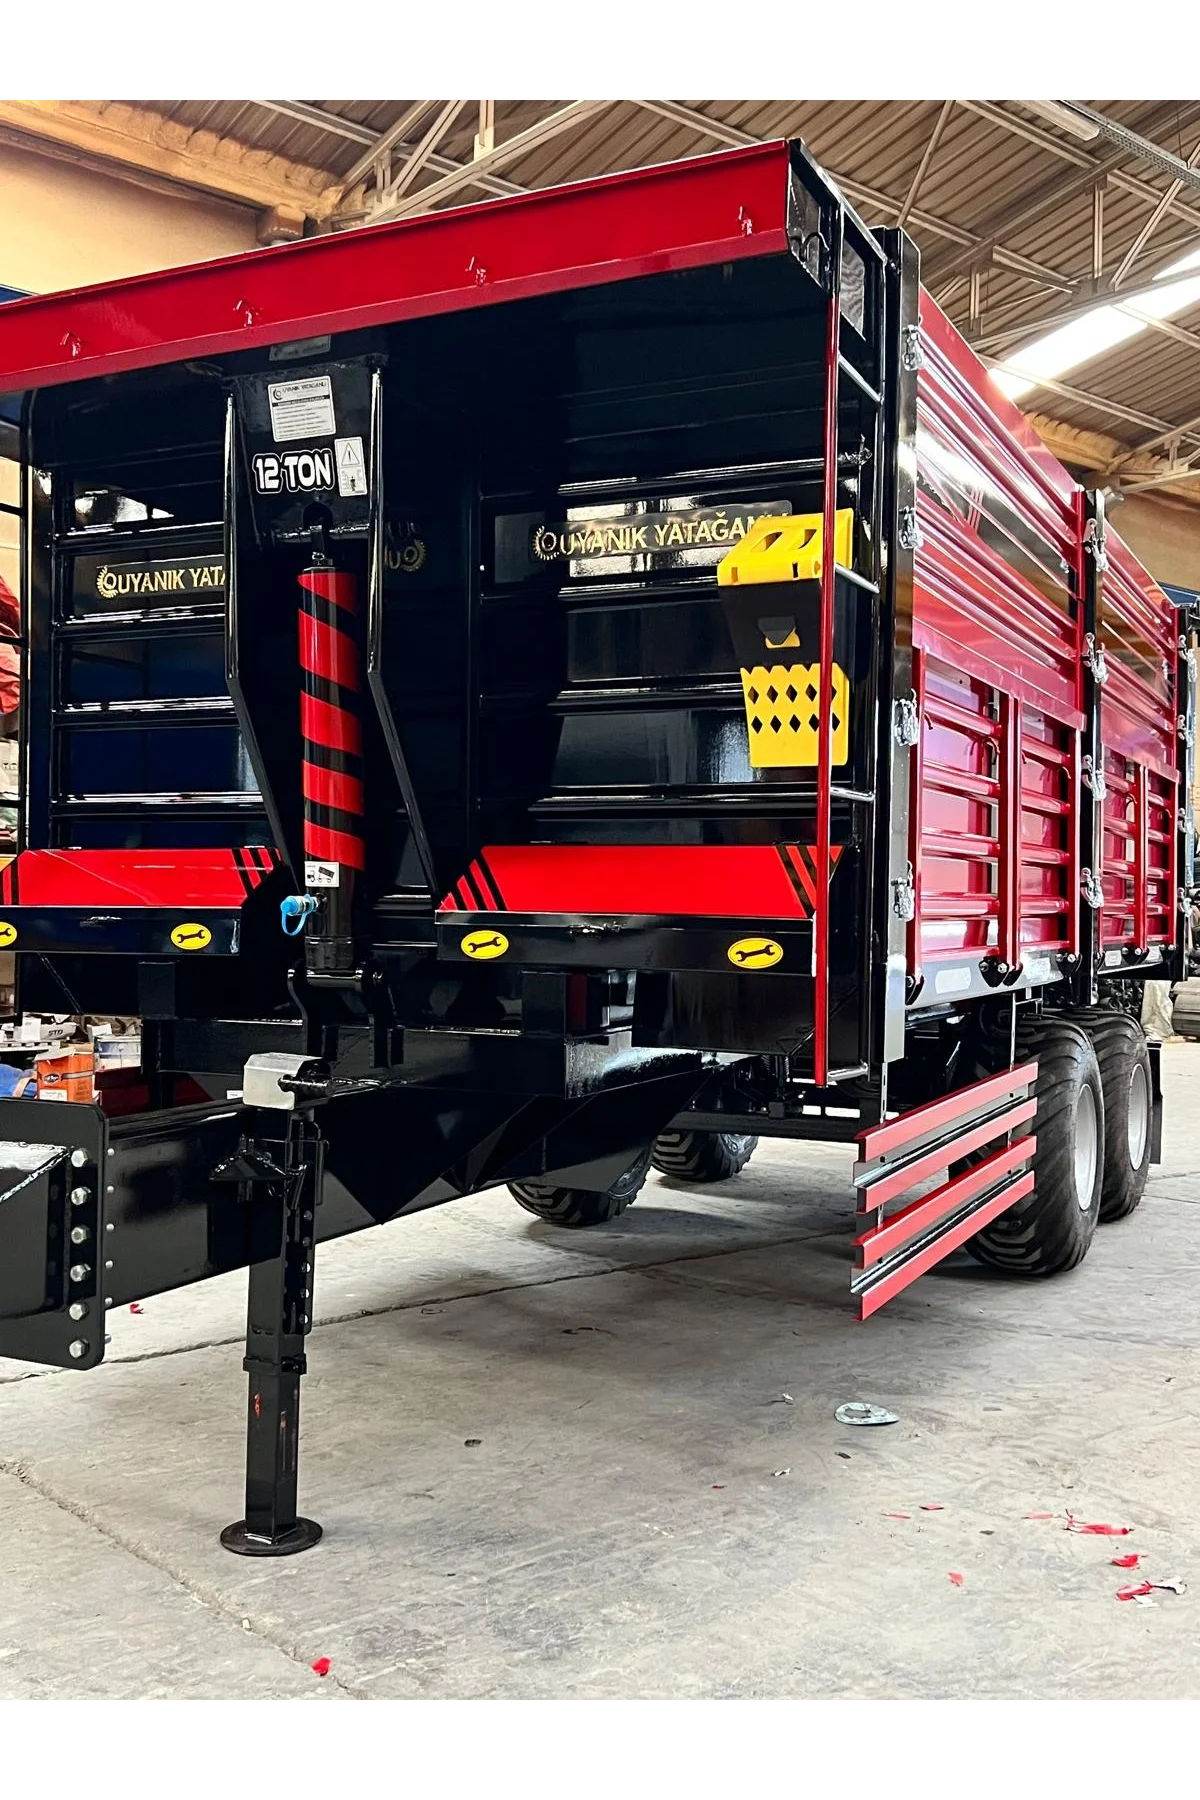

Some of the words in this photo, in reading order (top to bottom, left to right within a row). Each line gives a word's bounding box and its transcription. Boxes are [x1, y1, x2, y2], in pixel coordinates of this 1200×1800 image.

[254, 456, 281, 491] 12
[283, 452, 332, 489] TON
[560, 525, 649, 555] UYANIK
[654, 511, 788, 546] YATAĞA
[117, 569, 186, 594] UYANIK
